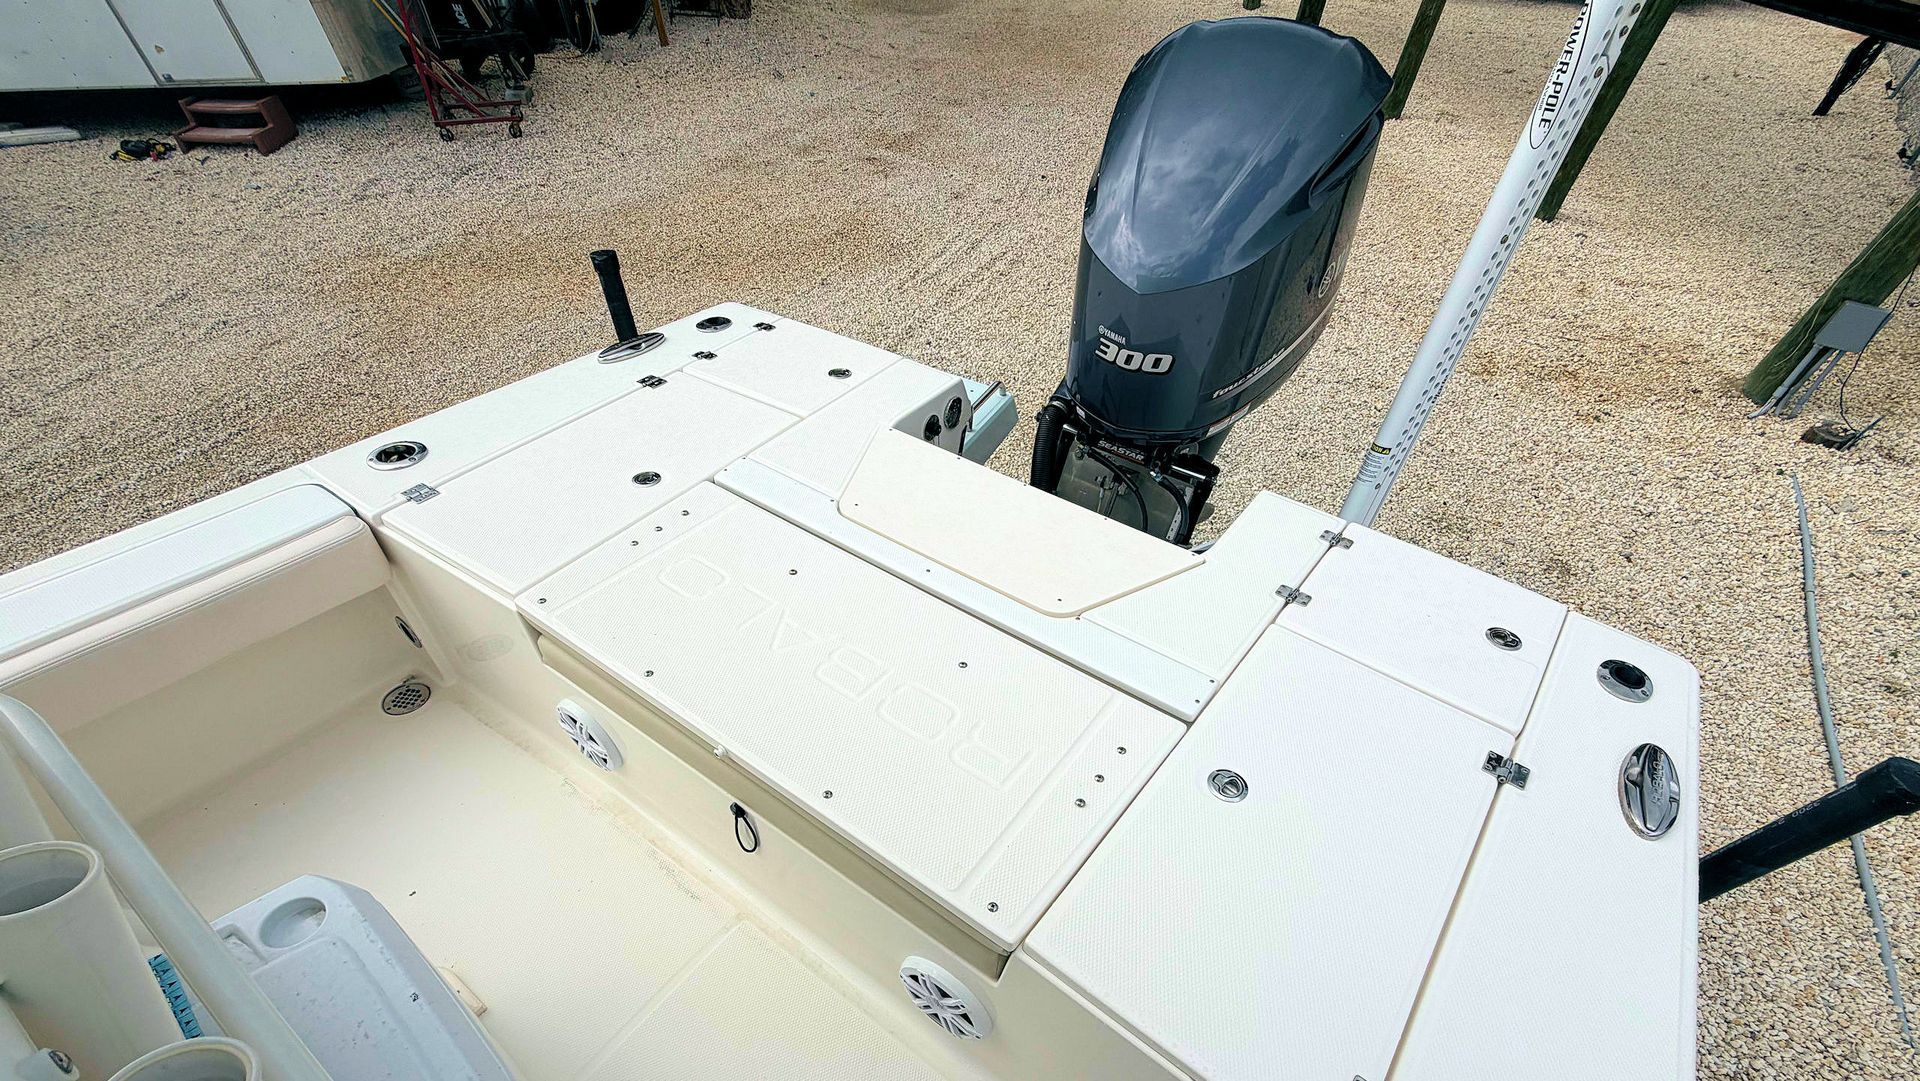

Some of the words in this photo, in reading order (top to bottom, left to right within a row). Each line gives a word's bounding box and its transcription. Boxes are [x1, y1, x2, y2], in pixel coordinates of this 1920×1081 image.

[1539, 2, 1589, 130] POWER-POLE
[1094, 337, 1174, 374] 300
[1104, 328, 1126, 346] YAMAHA
